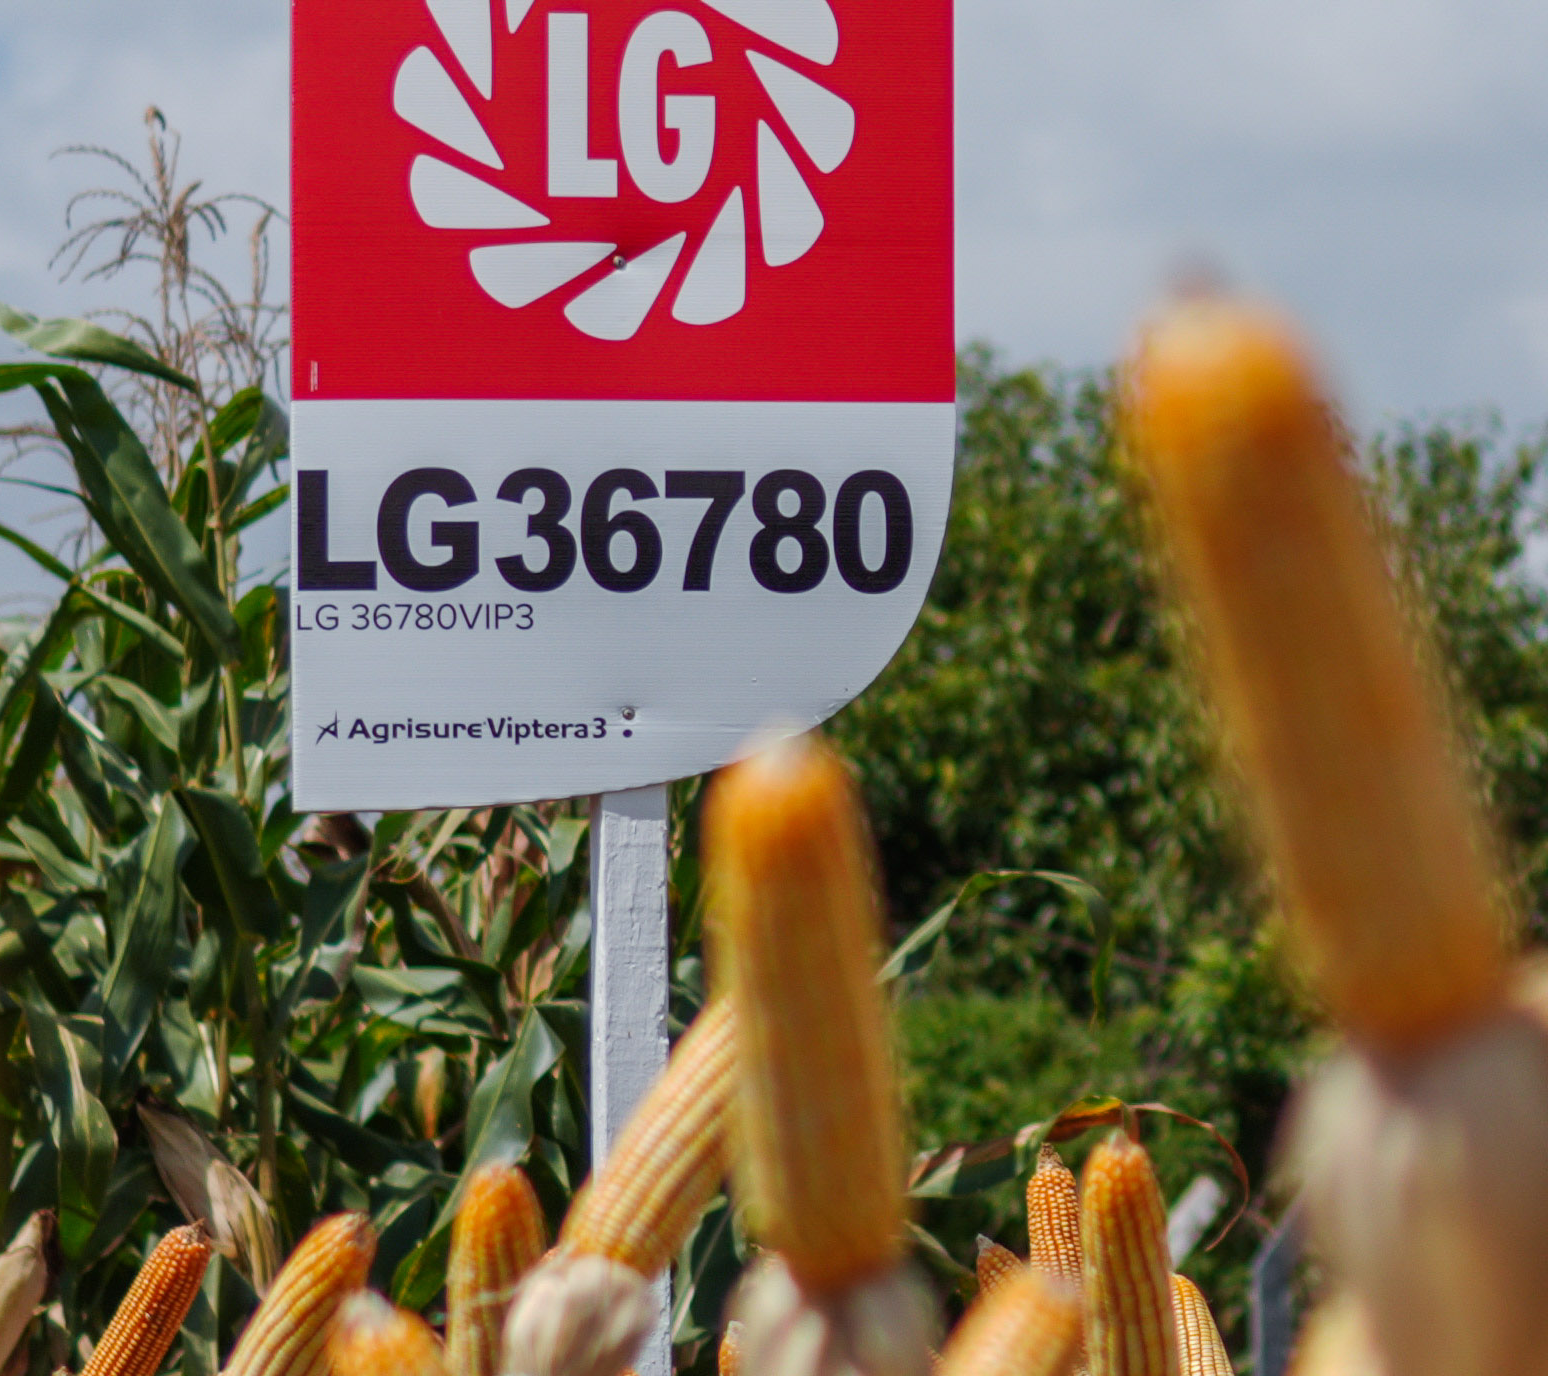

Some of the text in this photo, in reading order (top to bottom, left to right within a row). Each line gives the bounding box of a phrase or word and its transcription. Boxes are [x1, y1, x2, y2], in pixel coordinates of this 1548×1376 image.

[547, 10, 716, 204] LG
[297, 467, 914, 595] LG36780
[296, 603, 535, 631] LG 36780VIP3
